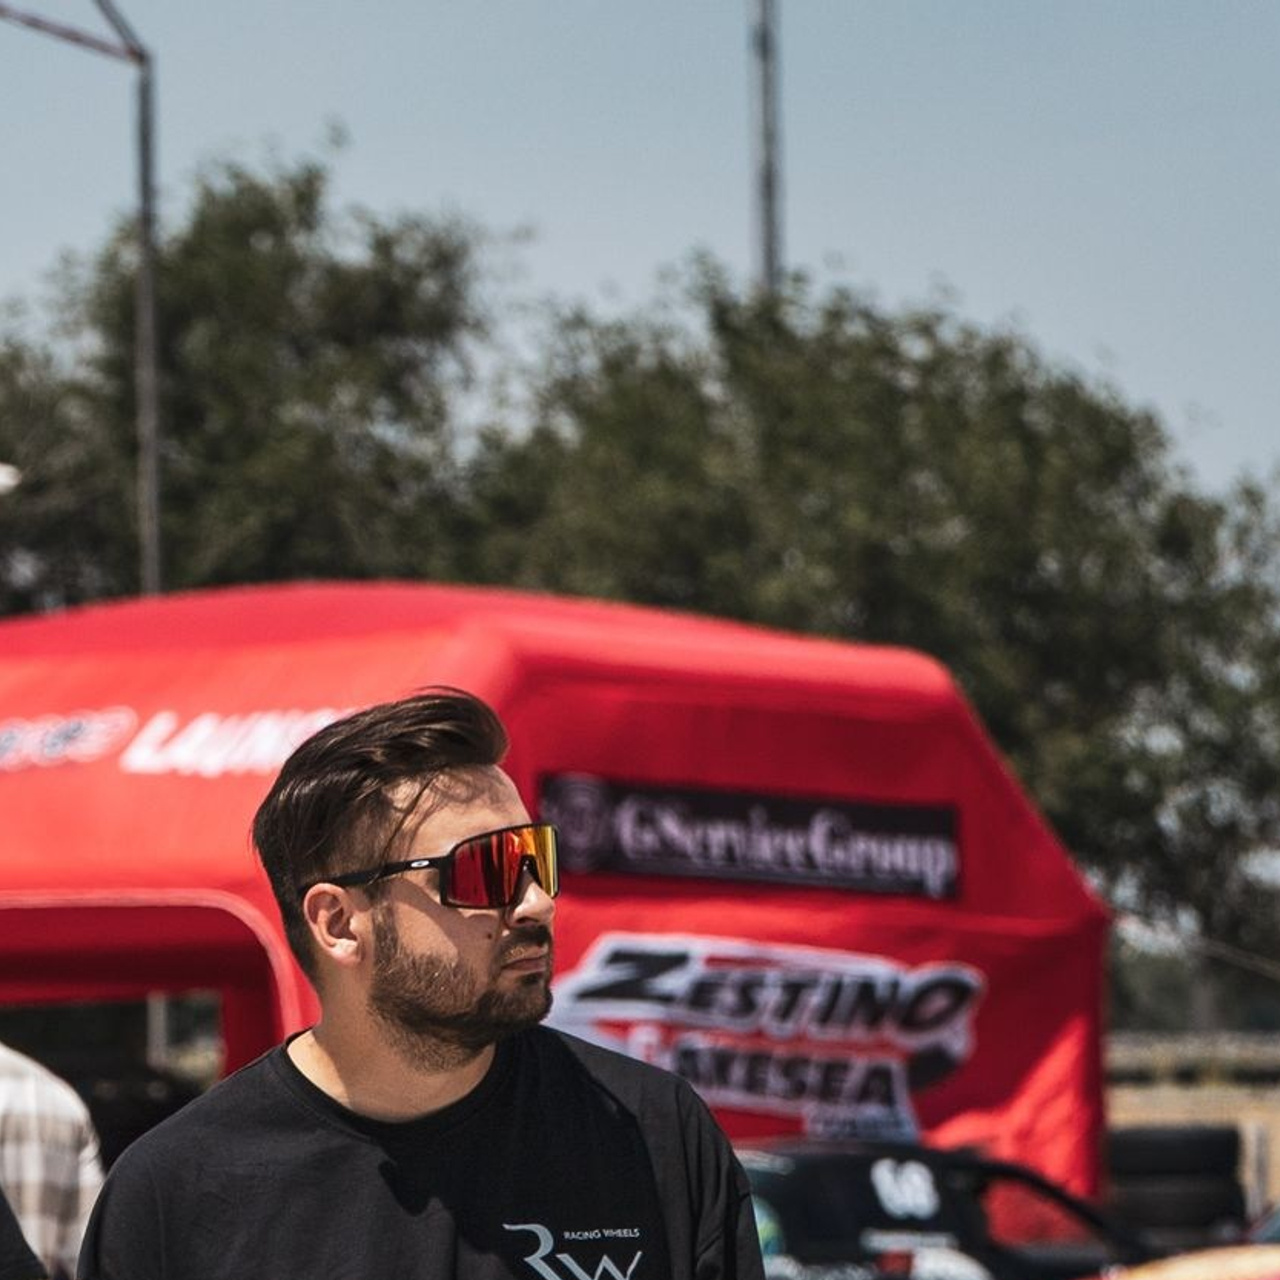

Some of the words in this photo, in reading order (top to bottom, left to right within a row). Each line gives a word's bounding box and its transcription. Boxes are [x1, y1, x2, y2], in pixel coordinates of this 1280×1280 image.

[574, 949, 978, 1033] ZESTINO
[563, 1229, 601, 1240] RACING
[602, 1228, 640, 1238] WHEELS
